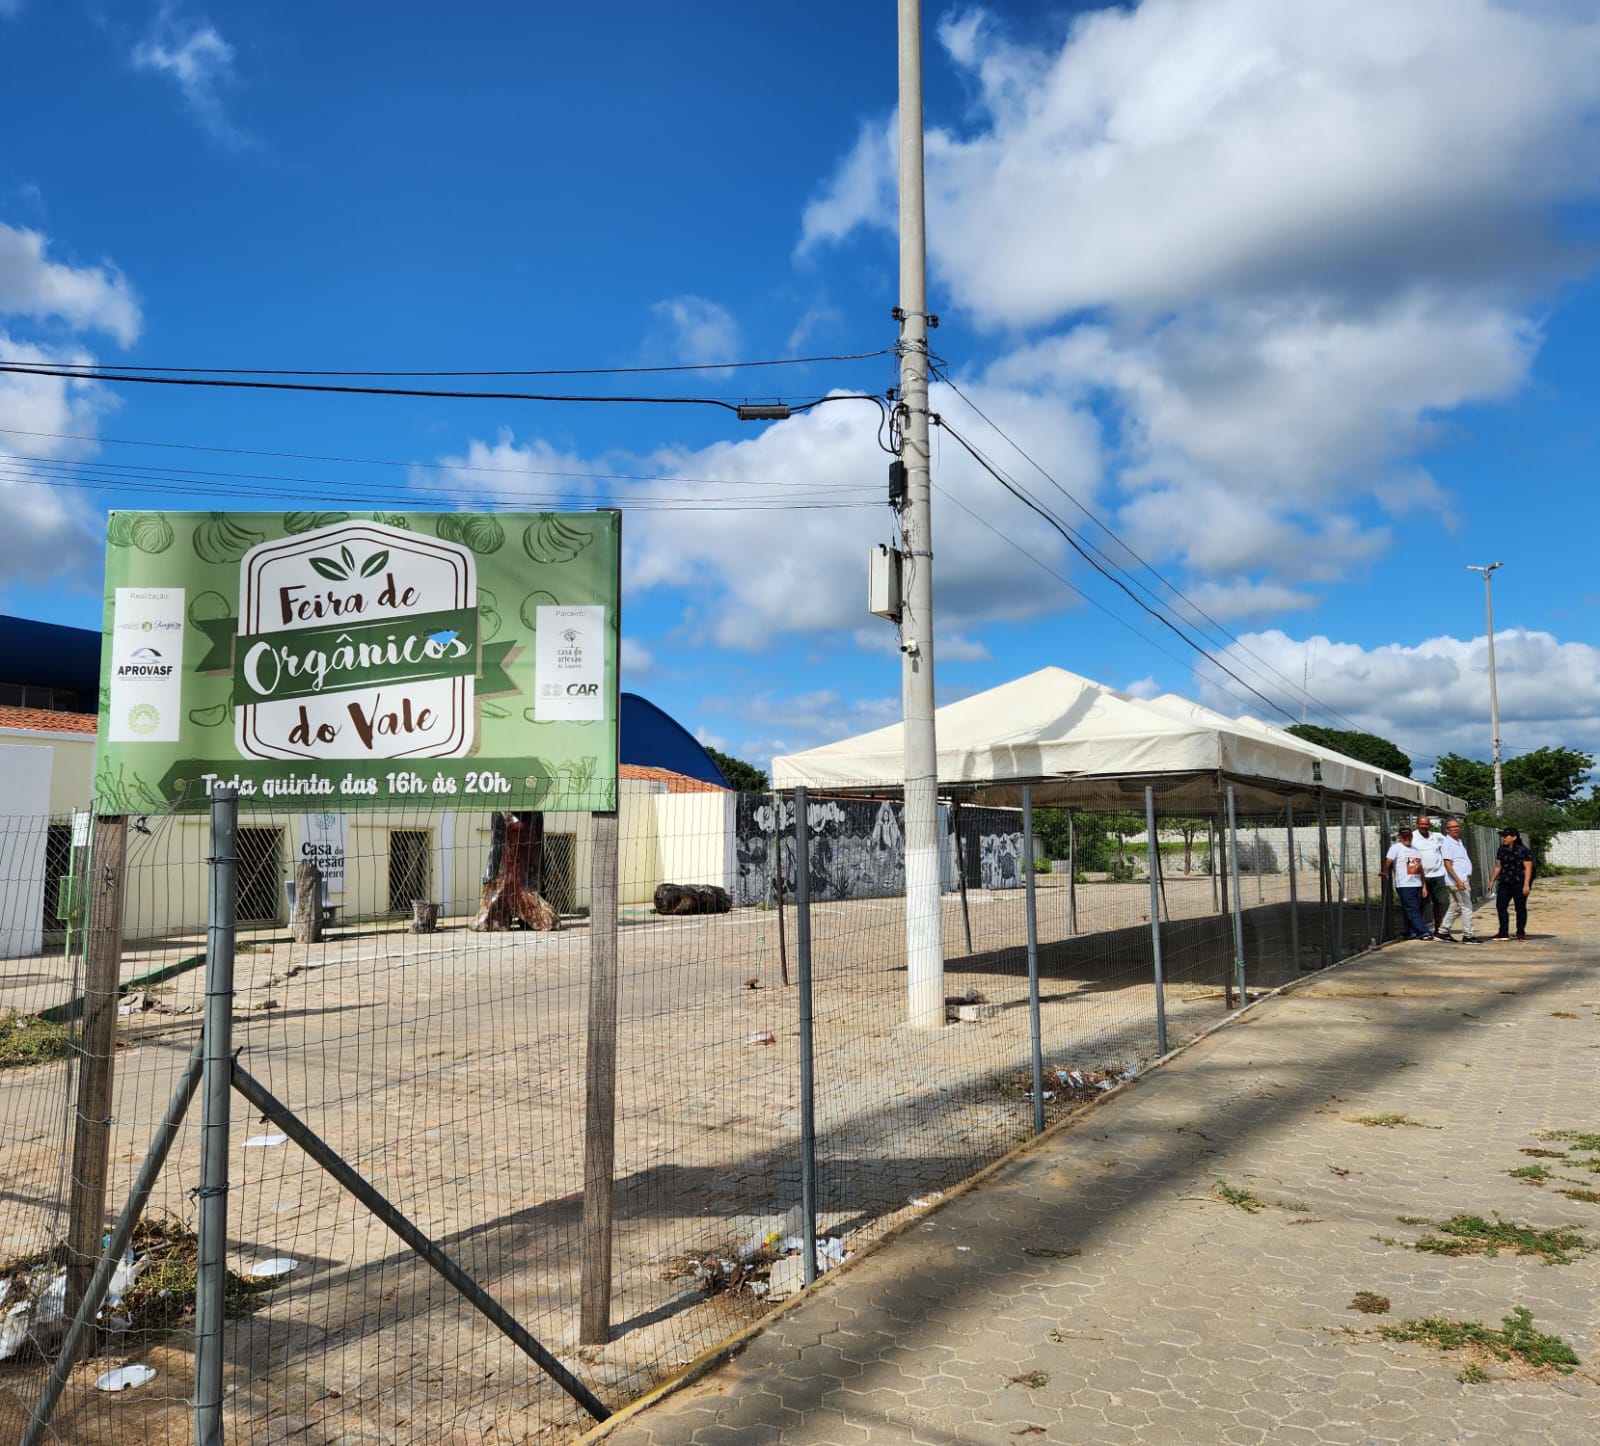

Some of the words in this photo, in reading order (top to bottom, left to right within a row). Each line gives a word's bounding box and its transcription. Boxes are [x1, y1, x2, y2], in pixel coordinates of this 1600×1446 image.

[130, 592, 169, 600] Realização
[279, 585, 368, 625] Feira
[377, 573, 420, 608] de
[117, 665, 174, 676] APROVASF
[243, 634, 472, 695] Orgânicos
[566, 683, 599, 696] CAR
[288, 705, 342, 746] do
[347, 693, 438, 750] Vale
[201, 773, 257, 796] Toda
[262, 774, 334, 798] quinta
[340, 773, 379, 795] das
[386, 772, 428, 795] 16h
[432, 772, 457, 795] às
[464, 771, 511, 794] 20h
[302, 841, 332, 855] Casa
